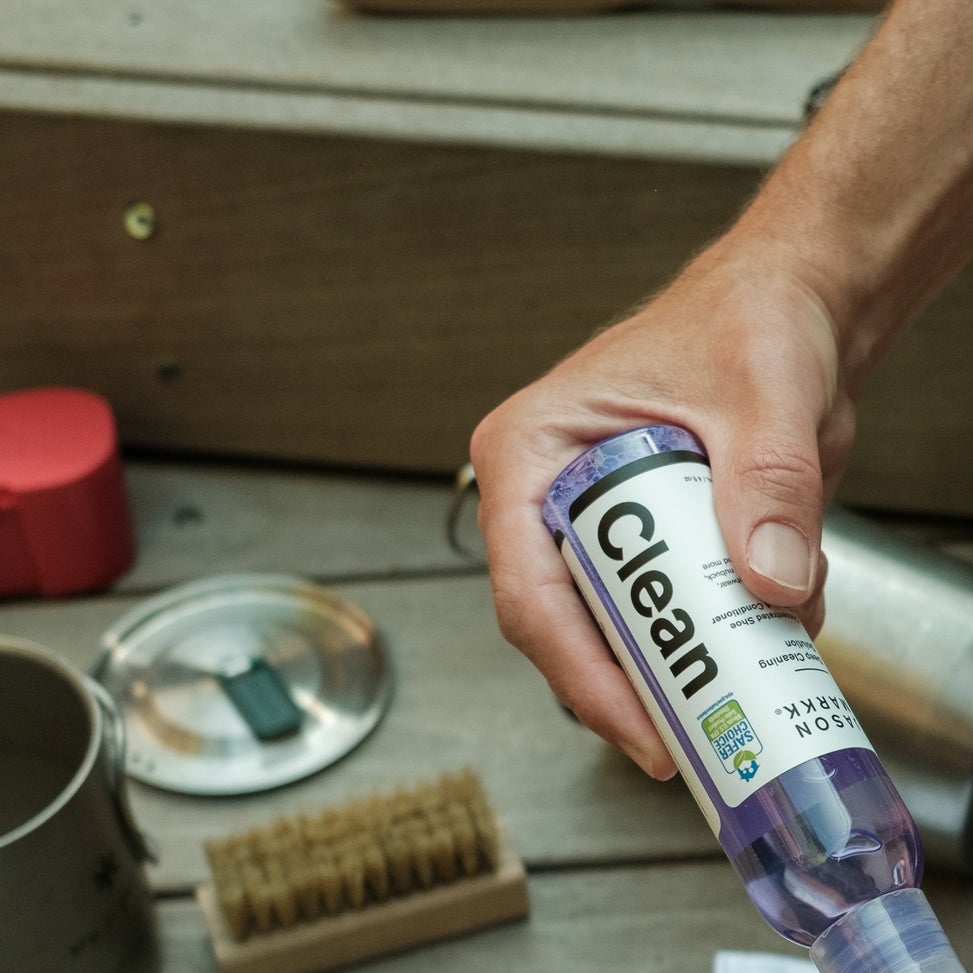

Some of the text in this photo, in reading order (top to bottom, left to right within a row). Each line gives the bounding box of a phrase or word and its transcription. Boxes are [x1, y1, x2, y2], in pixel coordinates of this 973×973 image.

[703, 560, 722, 570] more
[704, 567, 735, 581] nubuck,
[717, 577, 742, 588] twear,
[597, 501, 719, 701] Clean
[712, 602, 764, 624] Conditioner
[730, 617, 755, 630] Shoe
[758, 652, 805, 669] Cleaning
[713, 721, 748, 749] CHOICE
[719, 730, 754, 760] SAFER
